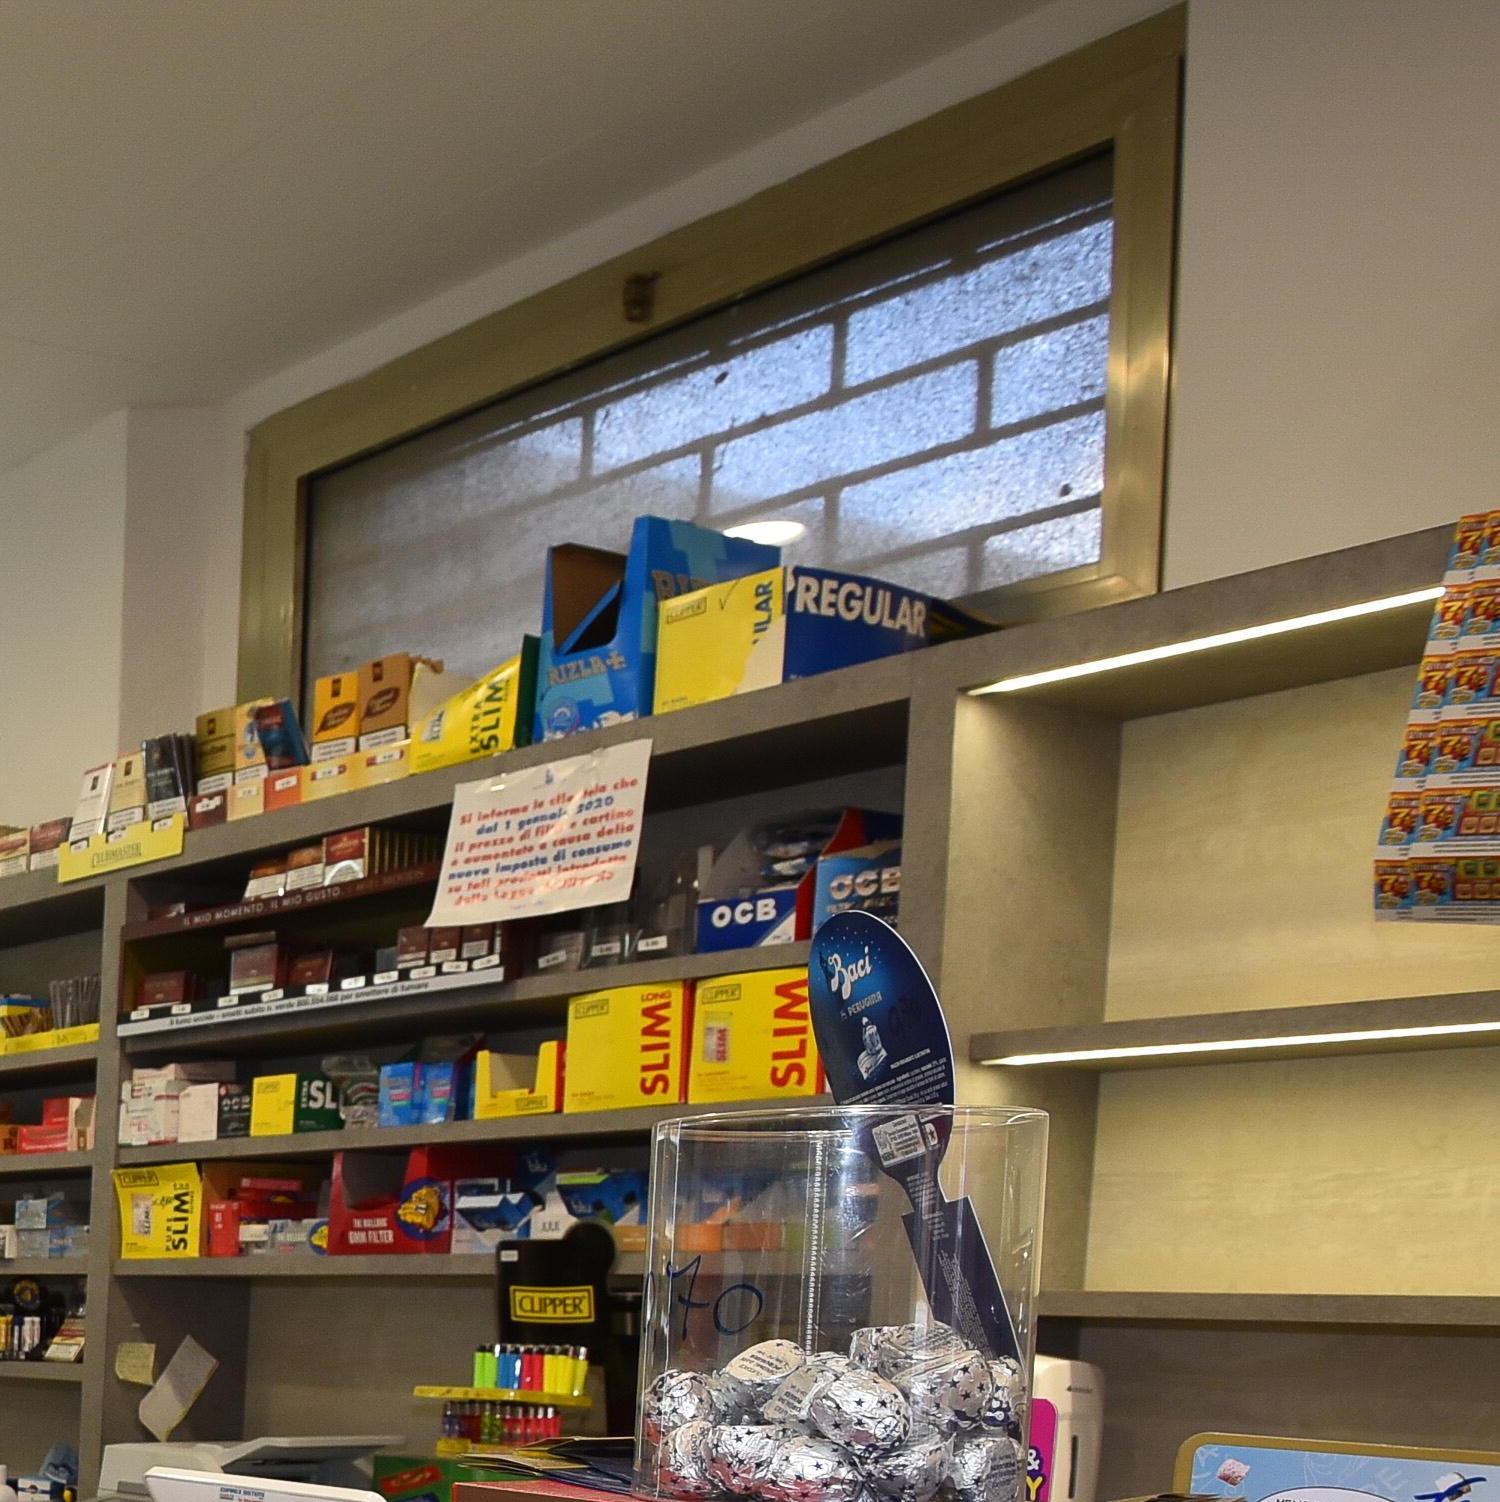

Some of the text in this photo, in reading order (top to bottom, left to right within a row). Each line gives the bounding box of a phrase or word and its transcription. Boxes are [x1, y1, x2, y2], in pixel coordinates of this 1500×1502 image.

[795, 574, 927, 638] REGULAR
[711, 898, 777, 928] OCB
[641, 991, 671, 1000] LONG
[828, 947, 873, 999] Baci
[640, 1002, 671, 1095] SLIM
[770, 979, 808, 1087] SLIM
[516, 1293, 587, 1316] CLIPPER
